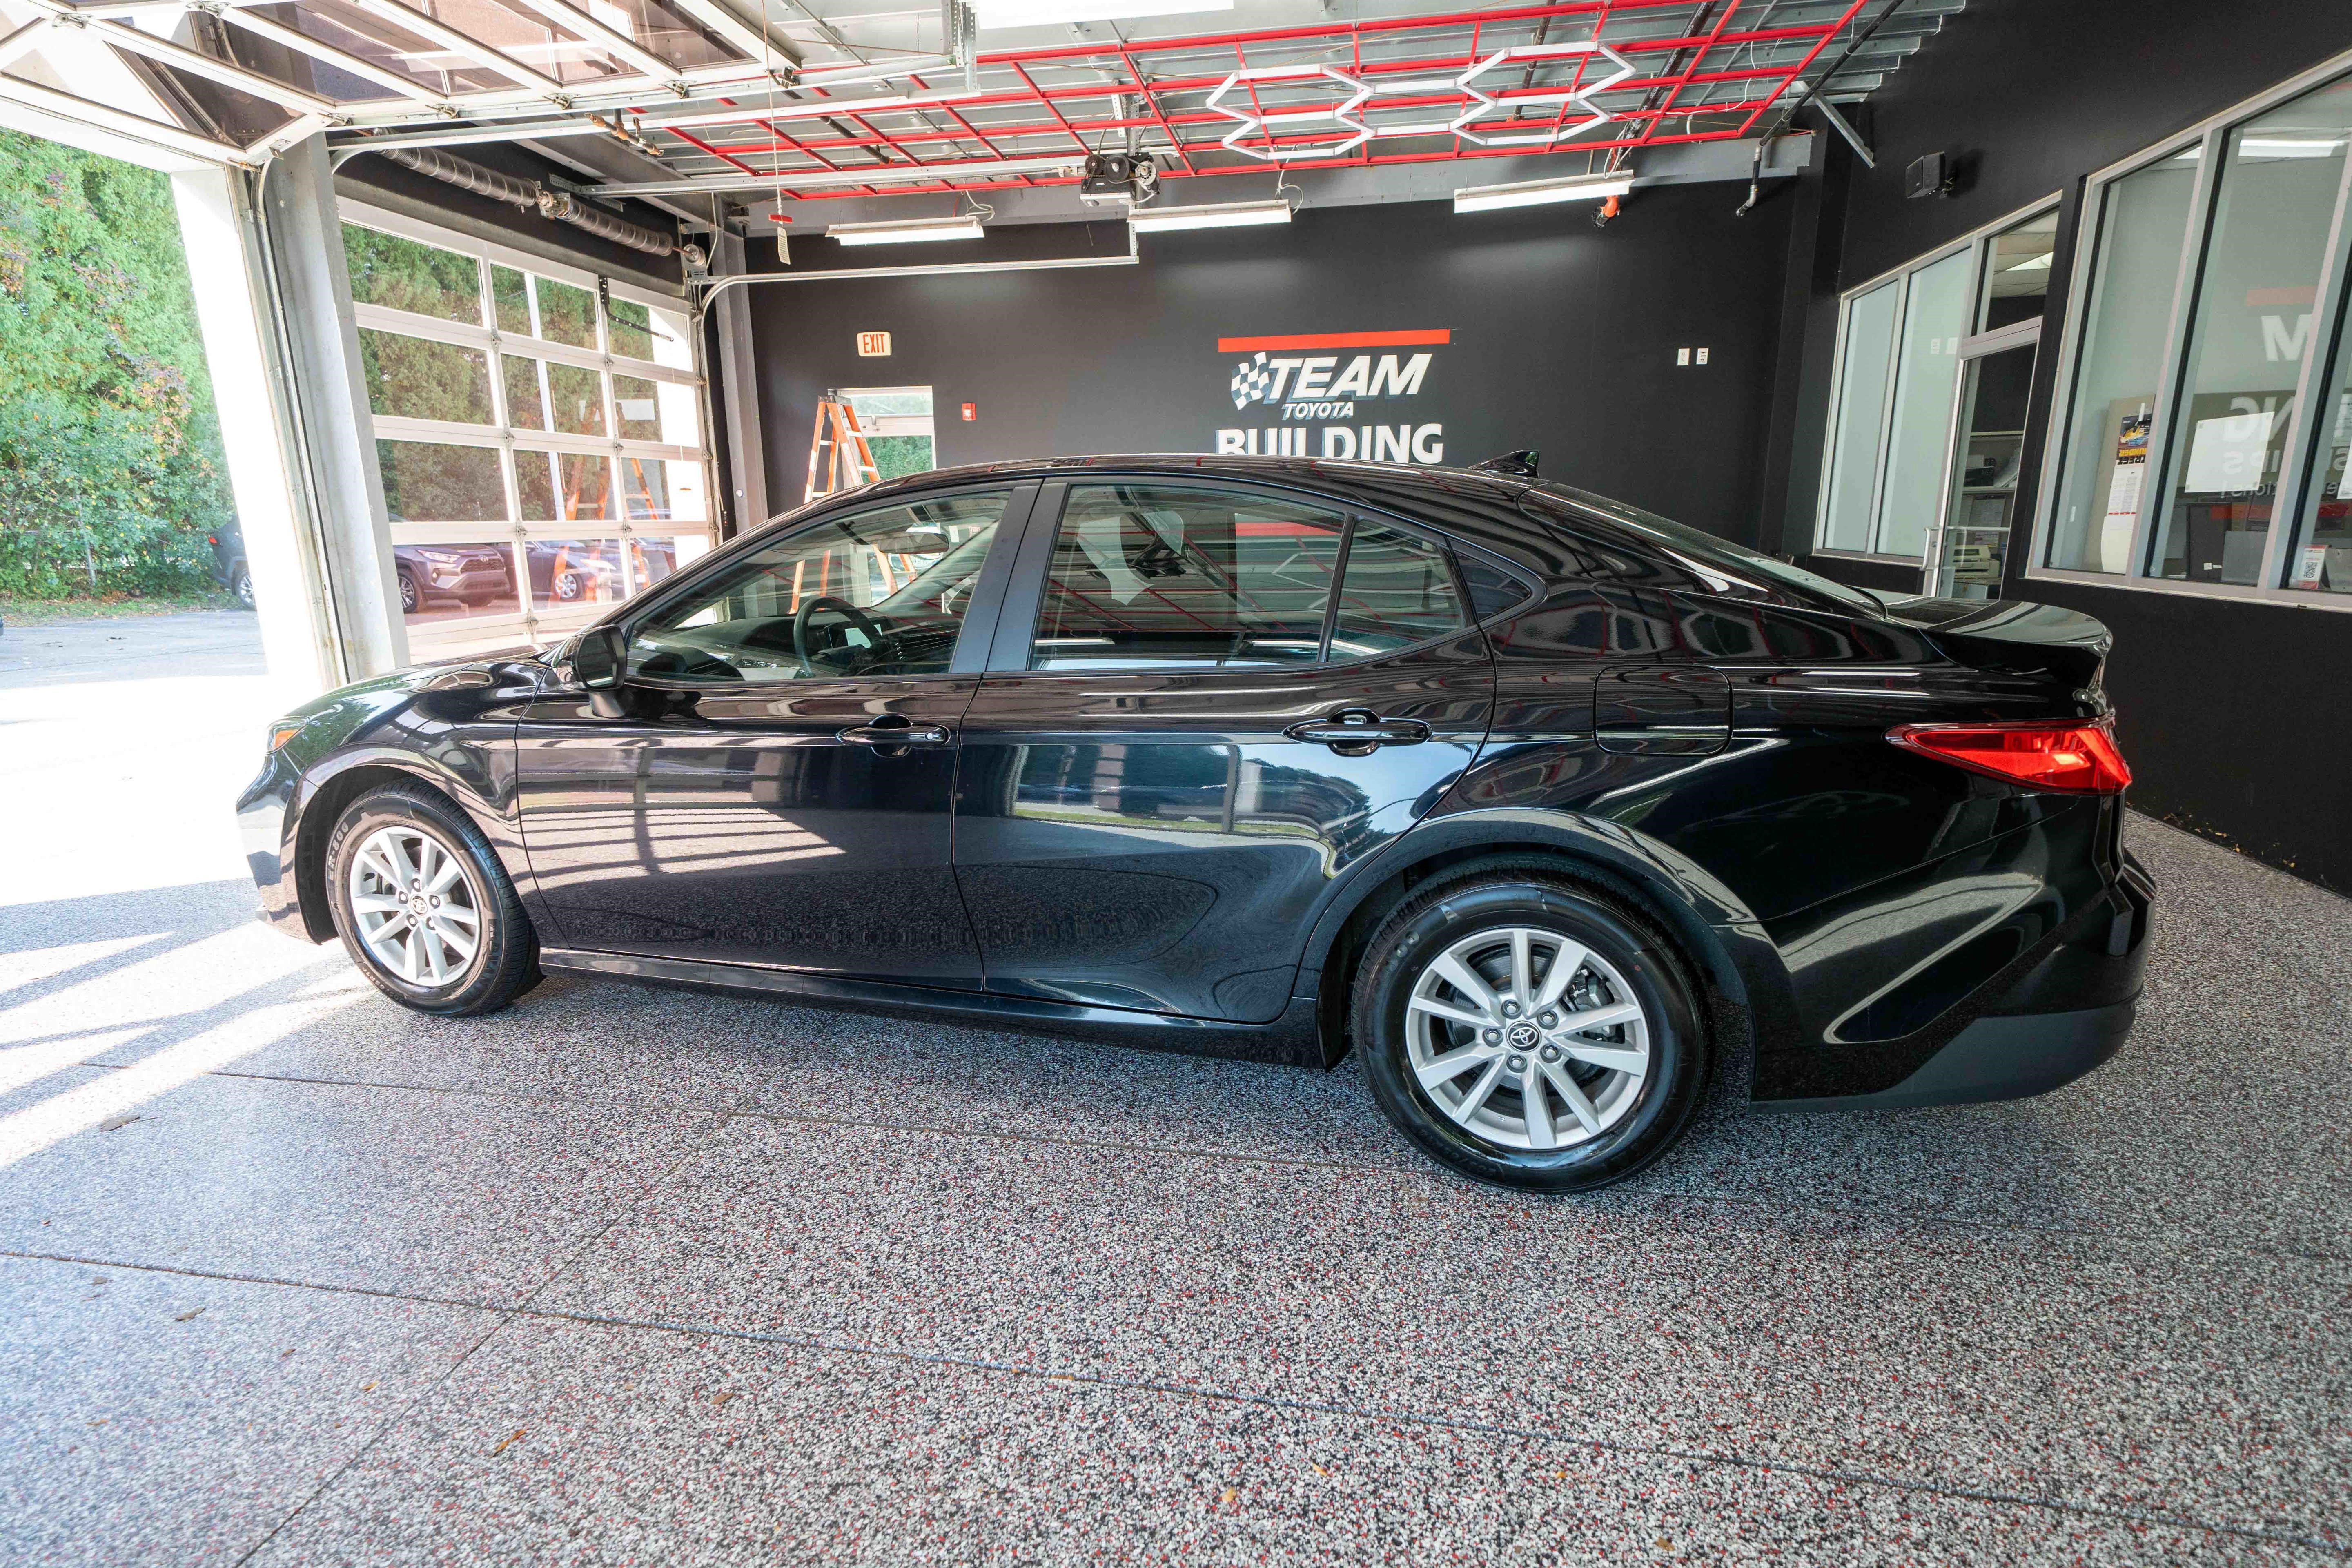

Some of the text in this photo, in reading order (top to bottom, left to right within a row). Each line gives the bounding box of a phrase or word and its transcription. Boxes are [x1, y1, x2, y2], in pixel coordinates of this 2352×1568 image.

[863, 333, 885, 354] EXIT
[1263, 353, 1433, 404] TEAM
[1282, 401, 1354, 421] TOYOTA
